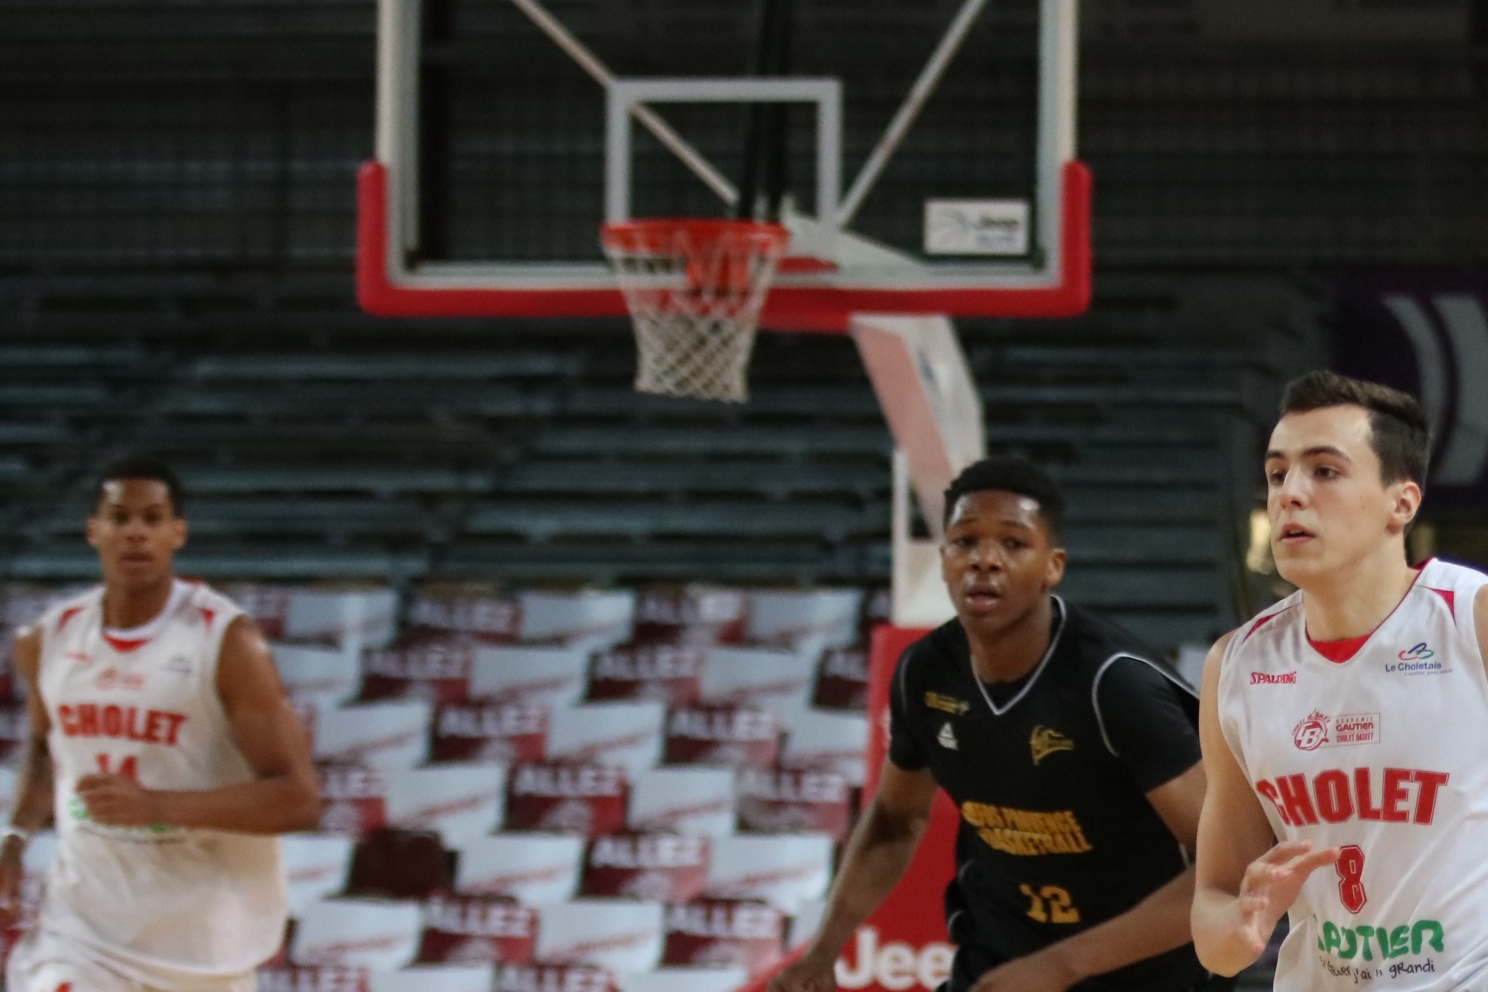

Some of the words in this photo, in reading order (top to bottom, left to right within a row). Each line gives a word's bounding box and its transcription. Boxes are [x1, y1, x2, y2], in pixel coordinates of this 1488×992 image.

[1385, 664, 1396, 672] Le
[1397, 661, 1442, 671] Choletais
[59, 703, 188, 745] CHOLET
[1335, 844, 1367, 914] 8
[1018, 883, 1081, 924] 12
[834, 927, 958, 990] Jee
[1318, 919, 1445, 961] AUTIER
